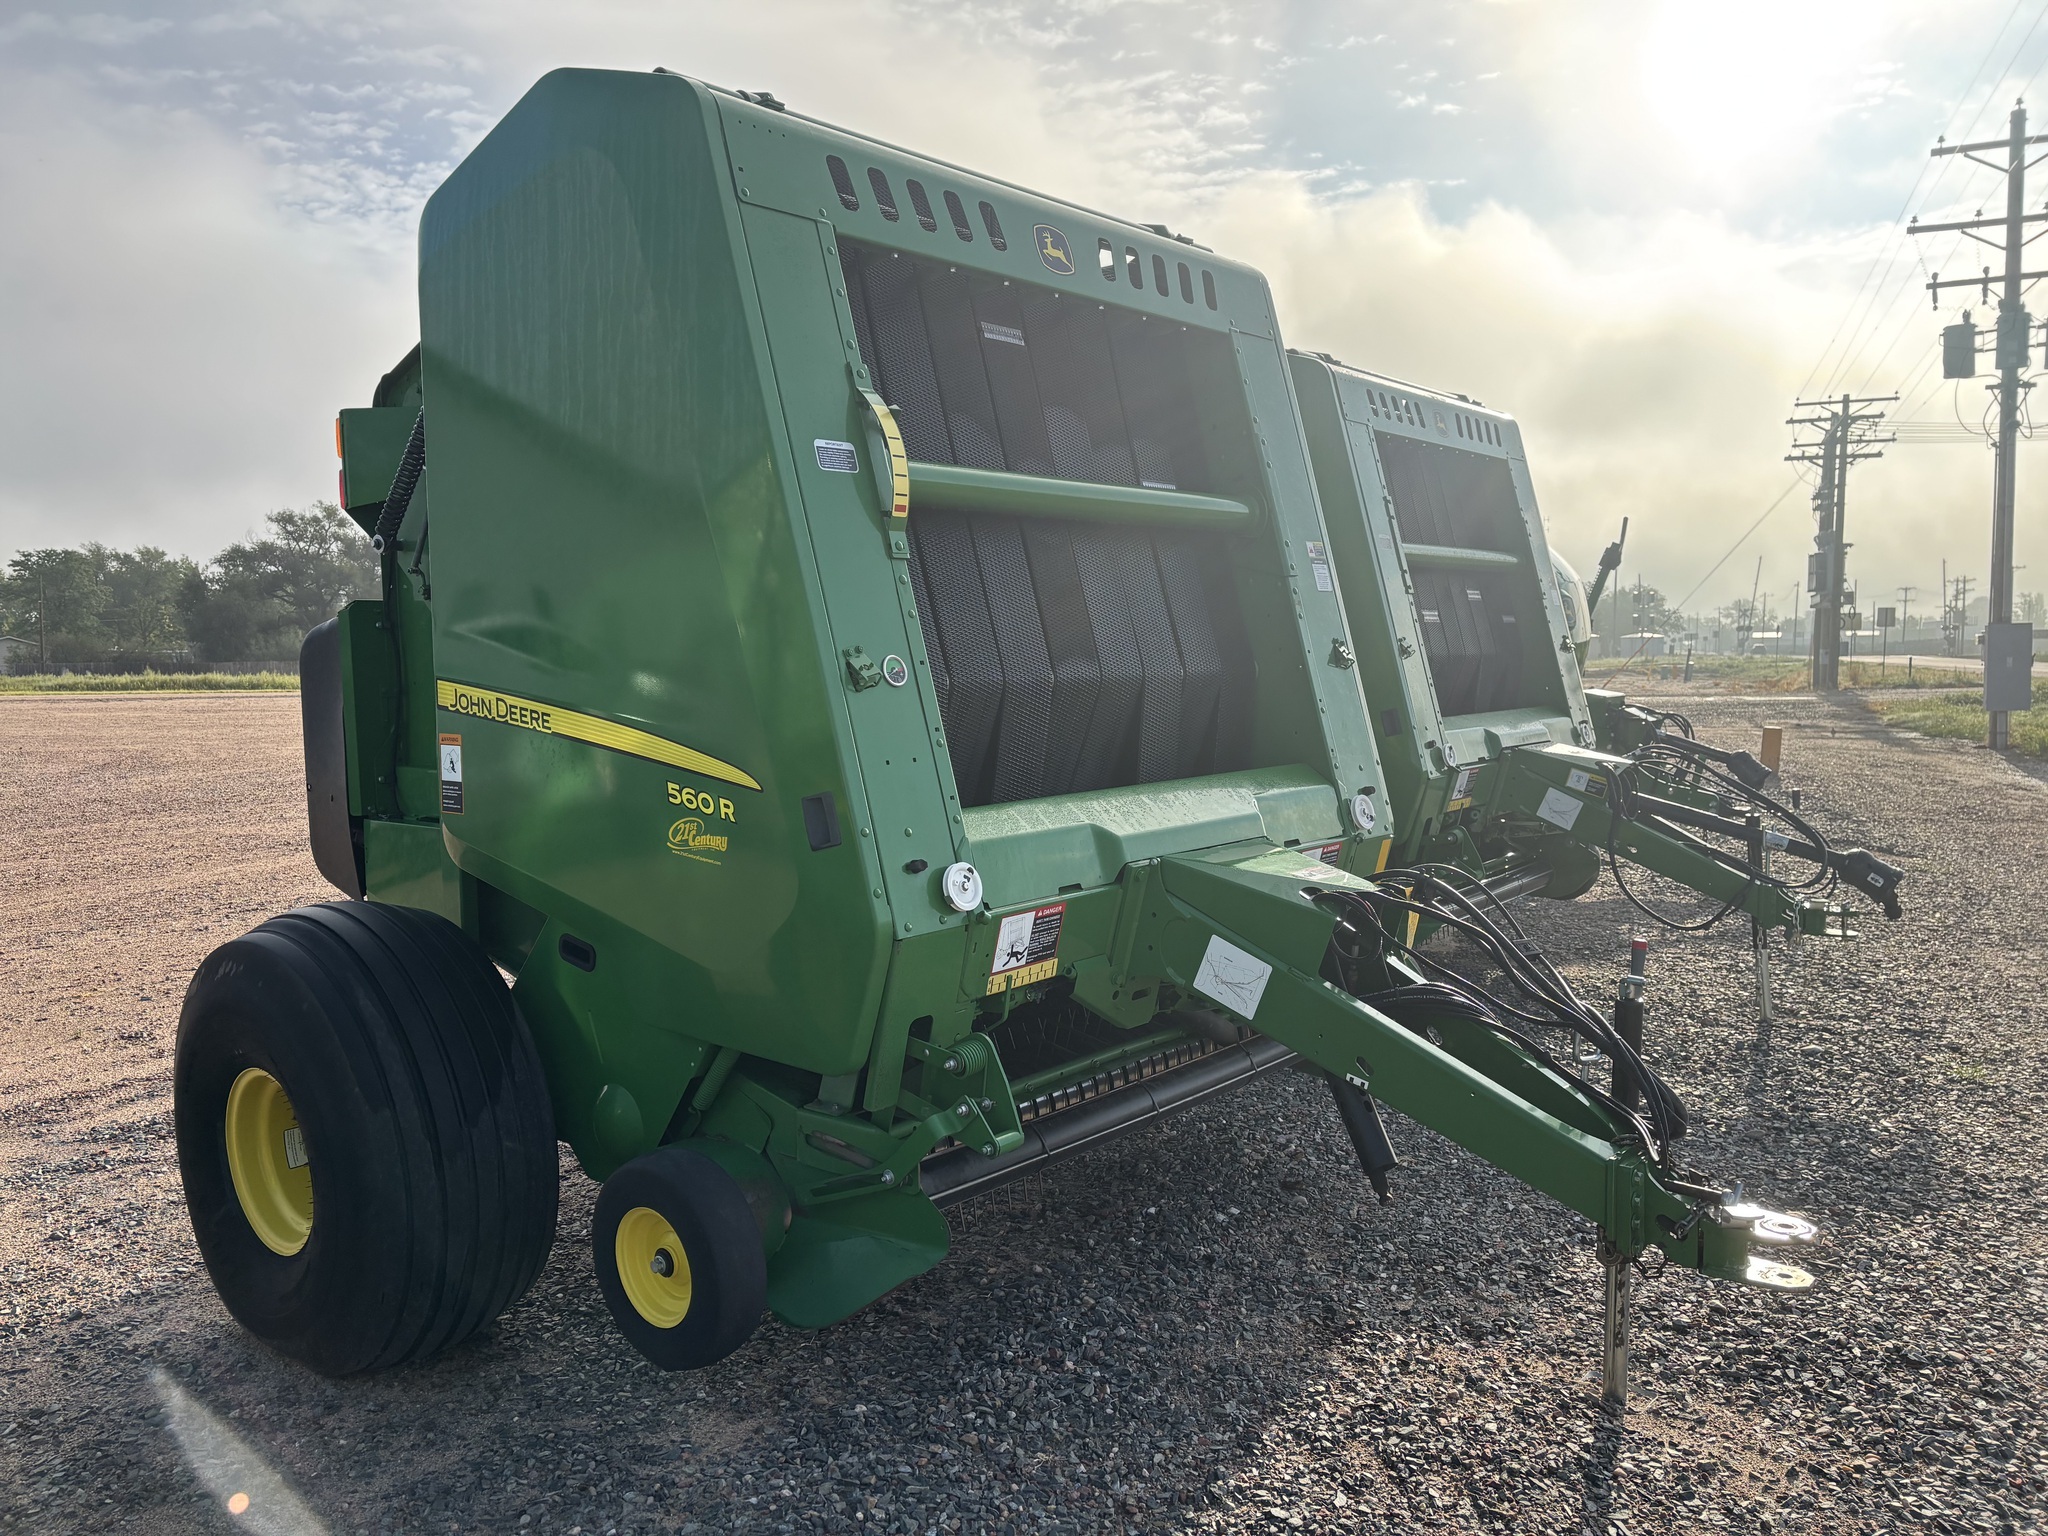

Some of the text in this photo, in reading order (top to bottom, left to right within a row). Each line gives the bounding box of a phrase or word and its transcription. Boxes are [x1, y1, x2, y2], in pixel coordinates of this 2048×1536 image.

[449, 688, 552, 731] JOHN DEERE
[666, 781, 737, 823] 560 R
[1042, 905, 1063, 915] DANGER
